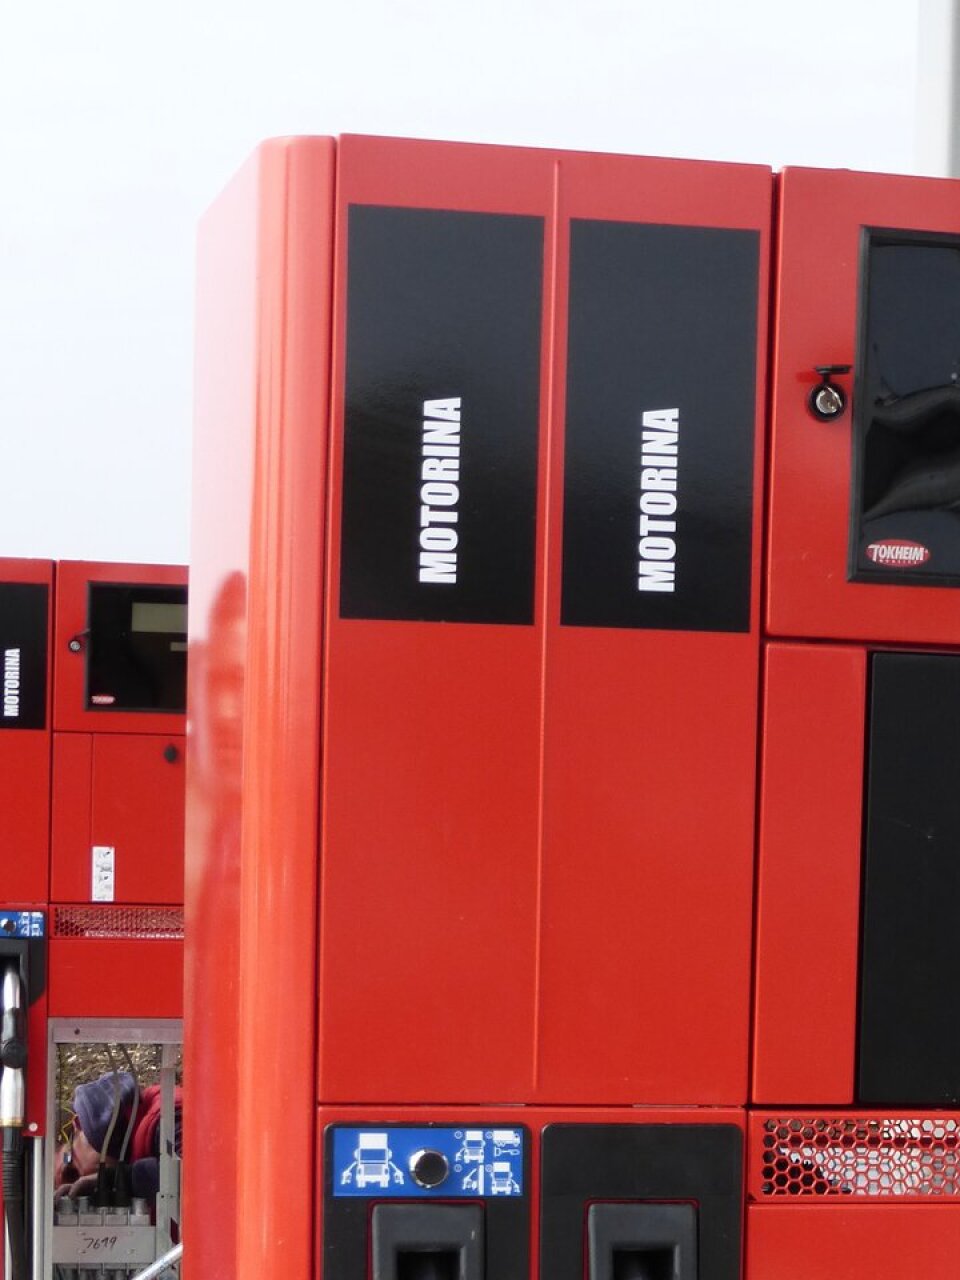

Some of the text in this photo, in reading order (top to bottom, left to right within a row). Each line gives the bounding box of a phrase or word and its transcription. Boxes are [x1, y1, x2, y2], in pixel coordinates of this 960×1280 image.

[418, 397, 462, 584] MOTORINA
[638, 407, 680, 592] MOTORINA
[868, 544, 925, 563] TOKHEIM
[3, 648, 21, 717] MOTORINA
